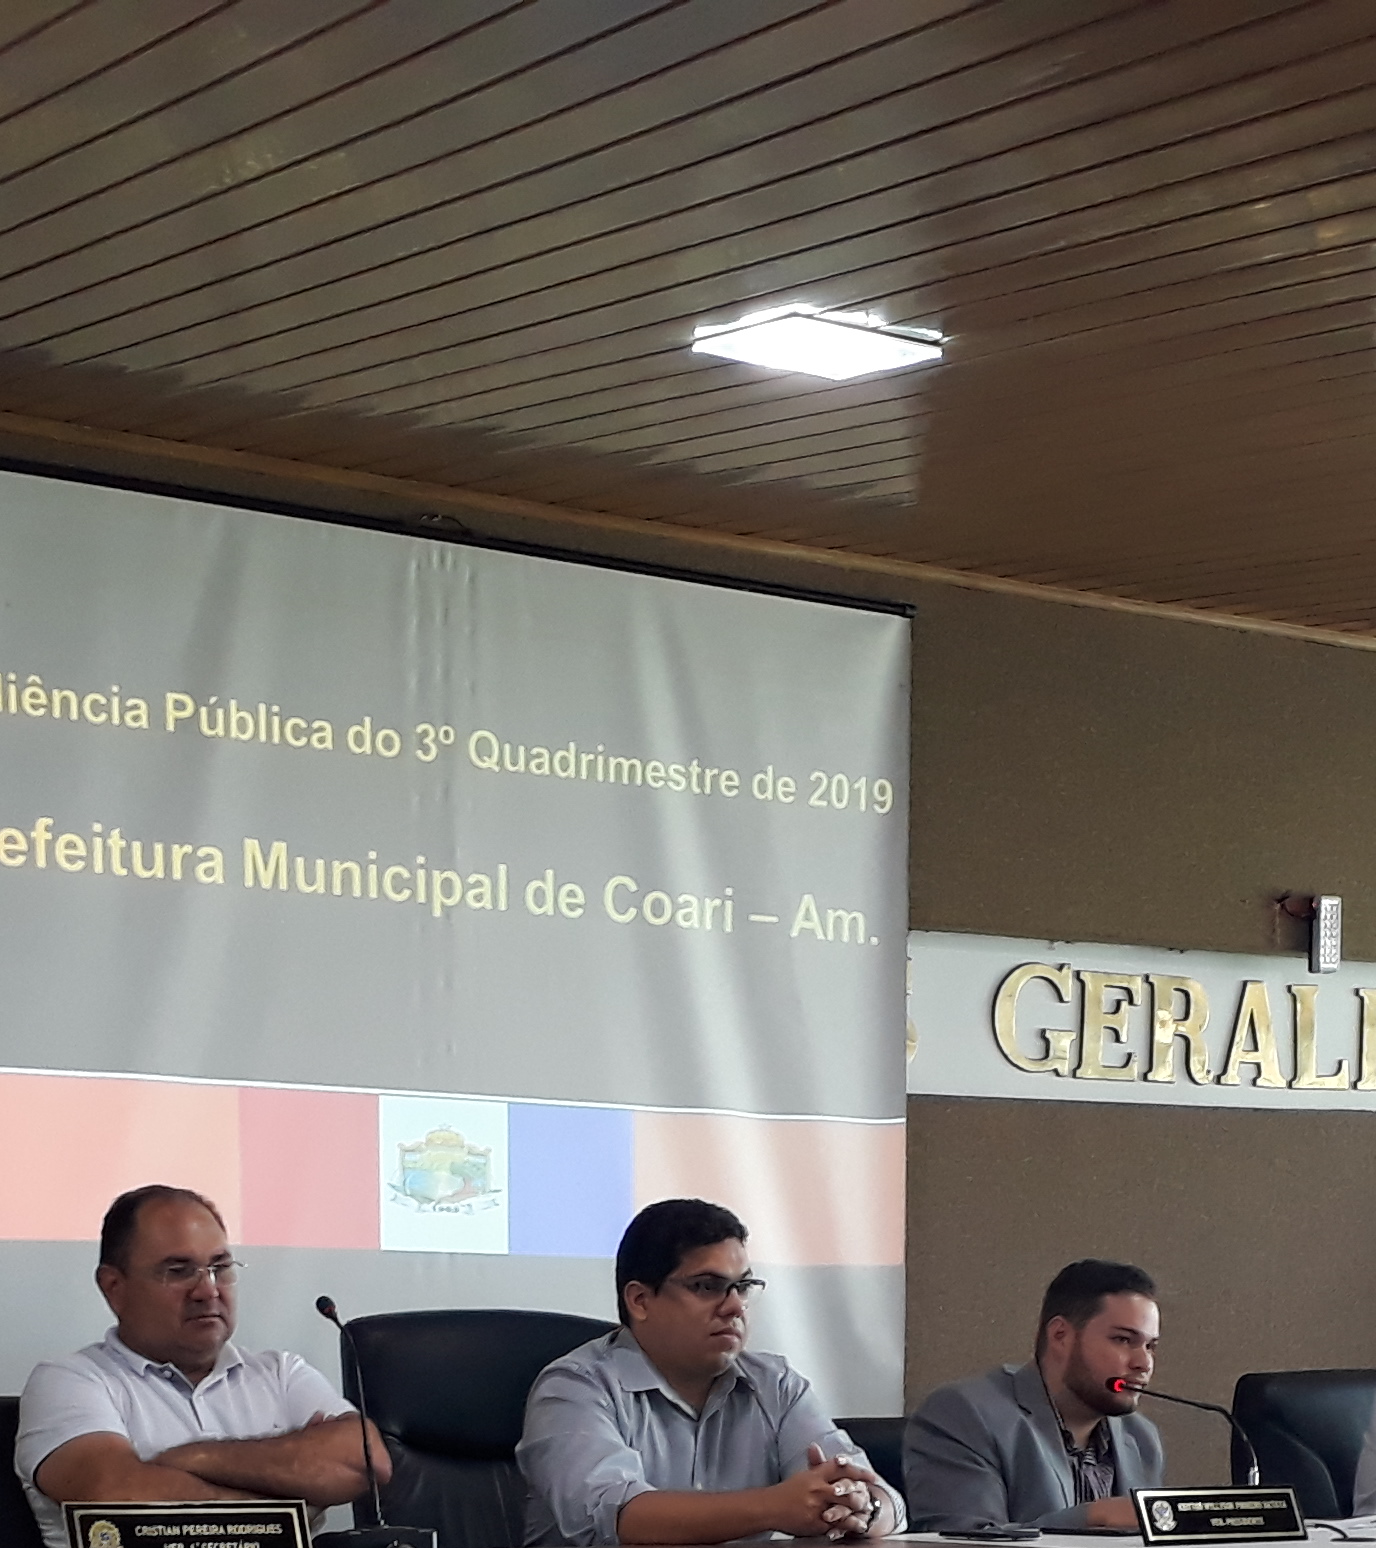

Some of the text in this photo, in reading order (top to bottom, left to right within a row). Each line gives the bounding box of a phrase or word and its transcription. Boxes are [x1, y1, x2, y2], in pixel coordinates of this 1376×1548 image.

[165, 691, 334, 751] Pública
[346, 716, 402, 759] do
[468, 730, 740, 798] Quadrimestre
[751, 765, 796, 804] de
[808, 771, 895, 815] 2019
[243, 837, 508, 917] Municipal
[525, 869, 585, 918] de
[603, 876, 734, 933] Coari
[789, 894, 881, 946] Am.
[182, 1524, 225, 1536] PEREIRA
[226, 1523, 284, 1536] RODRIGUES
